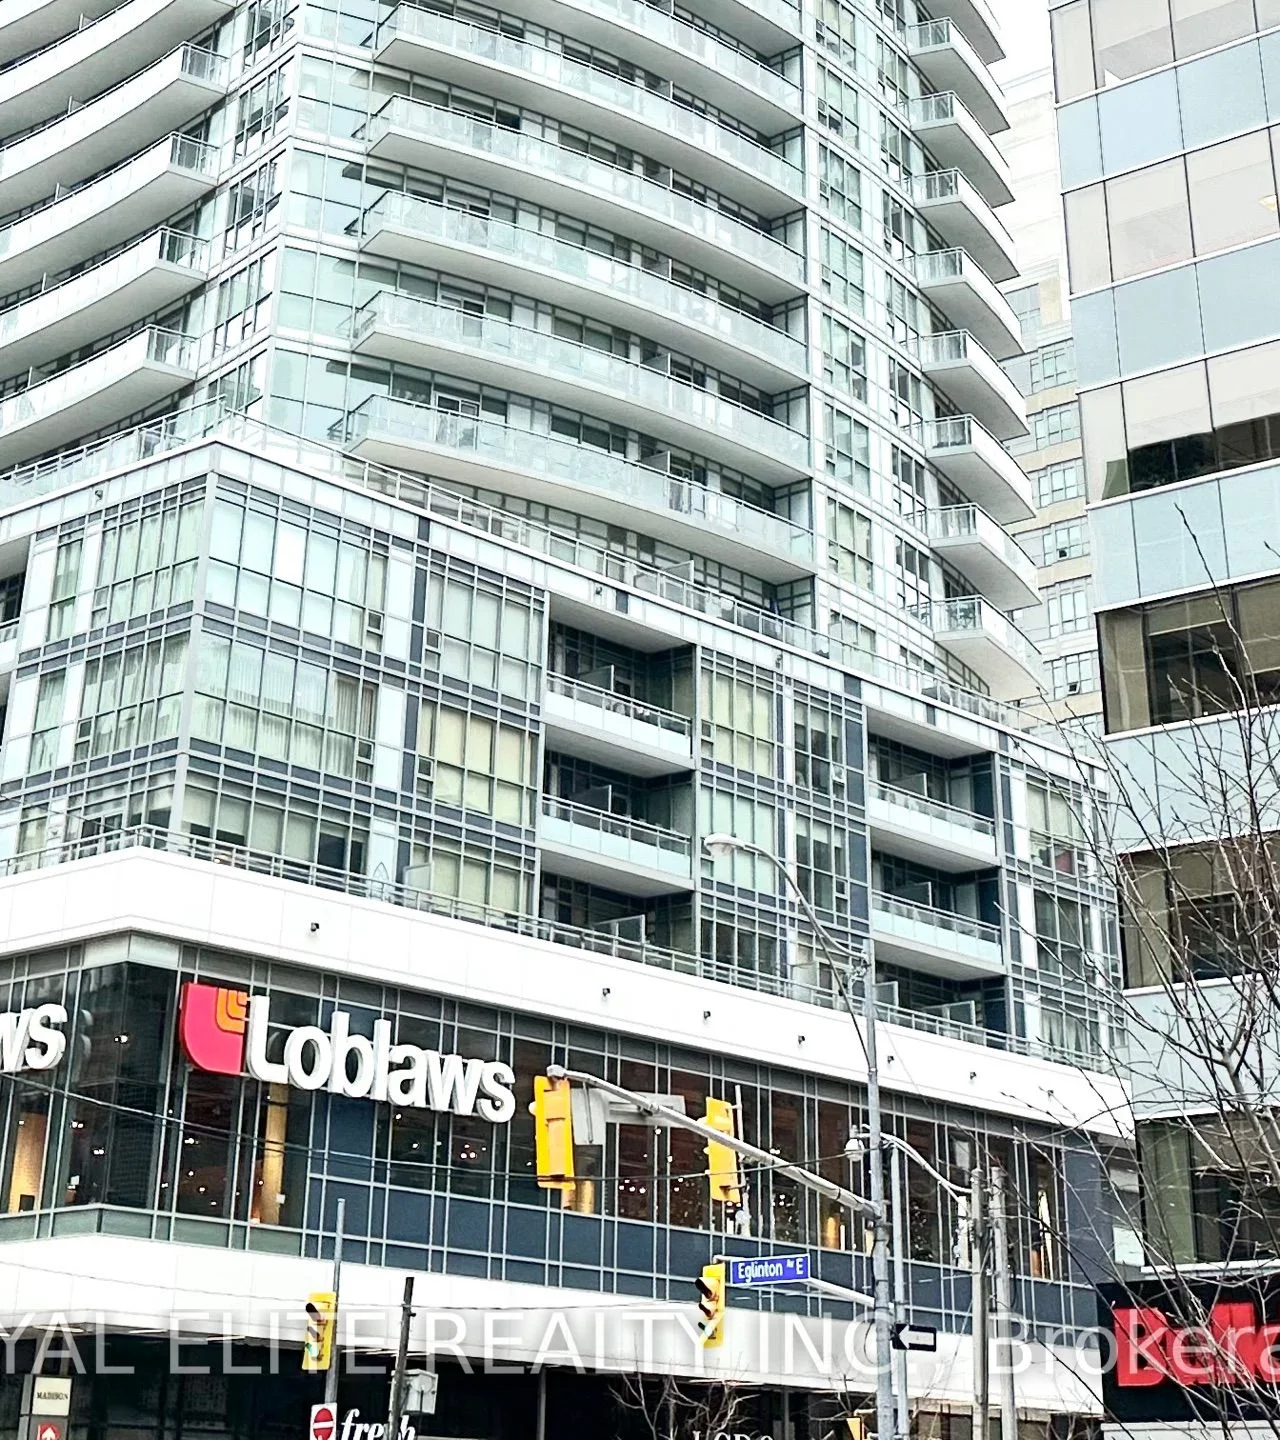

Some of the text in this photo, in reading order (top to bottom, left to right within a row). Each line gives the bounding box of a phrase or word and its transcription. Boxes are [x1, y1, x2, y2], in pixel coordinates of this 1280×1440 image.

[245, 994, 516, 1123] Loblaws
[738, 1261, 784, 1283] Eglinton
[795, 1257, 804, 1275] E
[340, 1408, 416, 1440] freh
